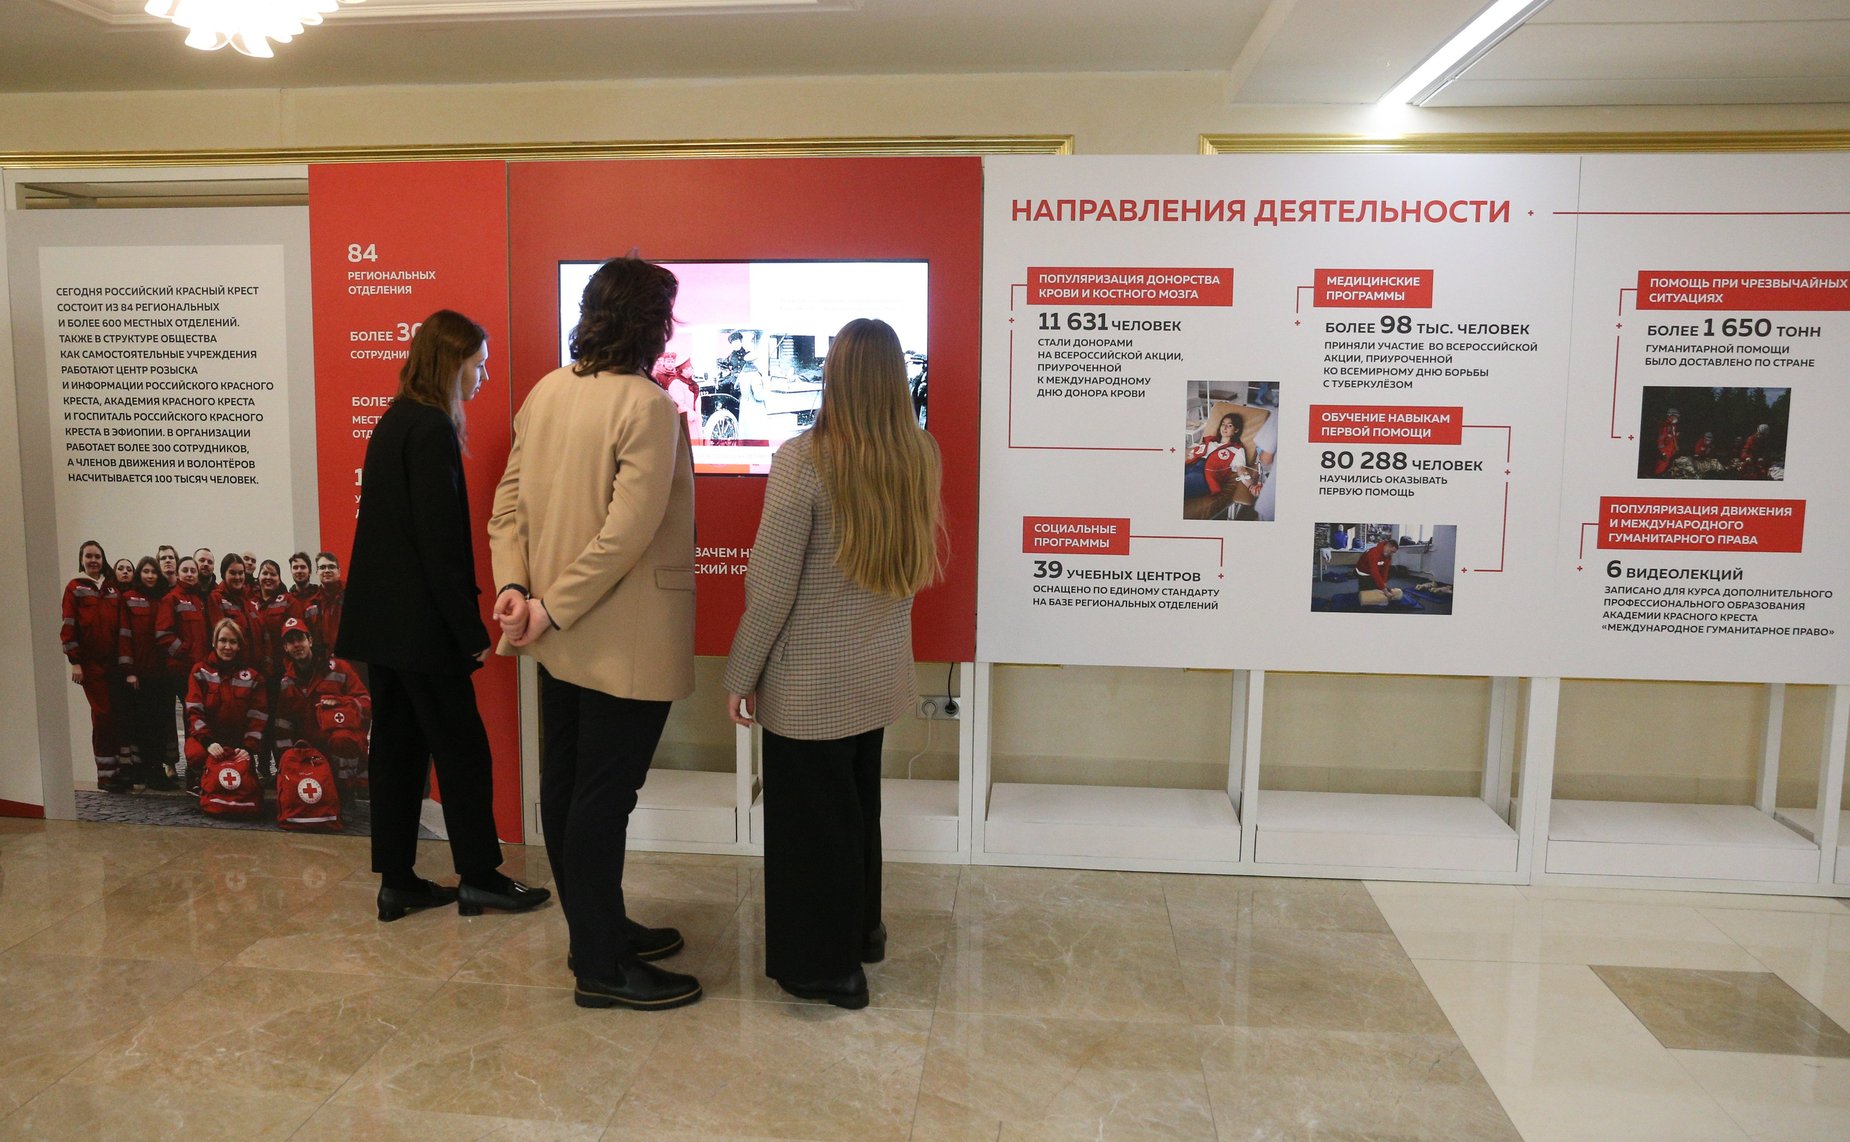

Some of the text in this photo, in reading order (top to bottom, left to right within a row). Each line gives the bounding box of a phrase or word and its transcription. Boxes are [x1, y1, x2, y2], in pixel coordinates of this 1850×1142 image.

[1011, 199, 1510, 226] НАПРАВЛЕНИЯ ДЕЯТЕЛЬНОСТИ
[347, 244, 378, 262] 84
[348, 271, 436, 280] РЕГИОНАЛЬНЫХ
[1039, 274, 1220, 286] ПОПУЛЯРИЗАЦИЯ ДОНОРСТВА
[1327, 276, 1420, 287] МЕДИЦИНСКИЕ
[1650, 277, 1848, 289] ПОМОЩЬ ПРИ ЧРЕЗВЫЧАЙНЫХ
[56, 285, 259, 297] СЕГОДНЯ РОССИЙСКИЙ КРАСНЫЙ КРЕСТ
[348, 286, 412, 295] ОТДЕЛЕНИЯ
[1039, 289, 1199, 299] КРОВИ И КОСТНОГО МОЗГА
[1326, 291, 1405, 301] ПРОГРАММЫ
[1649, 293, 1724, 304] СИТУАЦИЯХ
[57, 303, 220, 312] СОСТОИТ ИЗ 84 РЕГИОНАЛЬНЫХ
[67, 316, 240, 328] БОЛЕЕ 600 МЕСТНЫХ ОТДЕЛЕНИЙ.
[1039, 312, 1181, 331] 11 631 ЧЕЛОВЕК
[1325, 315, 1530, 335] БОЛЕЕ 98 ТЫС. ЧЕЛОВЕК
[1647, 318, 1821, 337] БОЛЕЕ 1 650 ТОНН
[59, 334, 217, 344] ТАКЖЕ СТРУКТУРЕ ОБЩЕСТВА
[350, 331, 393, 341] БОЛЕЕ
[1038, 339, 1133, 348] СТАЛИ ДОНОРАМИ
[1324, 341, 1538, 352] ПРИНЯЛИ УЧАСТИЕ ВО ВСЕРОССИЙСКОЙ
[1646, 343, 1790, 355] ГУМАНИТАРНОЙ ПОМОЩИ
[60, 350, 257, 360] КАК САМОСТОЯТЕЛЬНЫЕ УЧРЕЖДЕНИЯ
[1037, 350, 1184, 362] НА ВСЕРОССИЙСКОЙ АКЦИИ,
[1324, 353, 1453, 365] АКЦИИ, ПРИУРОЧЕННОЙ
[1037, 363, 1122, 373] ПРИУРОЧЕННОЙ
[1645, 357, 1815, 368] БЫЛО ДОСТАВЛЕНО ПО СТРАНЕ
[61, 366, 199, 376] РАБОТАЮТ ЦЕНТР РОЗЫСКА
[1323, 367, 1489, 378] КО ВСЕМИРНОМУ ДНЮ БОРЬБЫ
[71, 379, 274, 391] ИНФОРМАЦИИ РОССИЙСКОГО КРАСНОГО
[1037, 376, 1151, 387] К МЕЖДУНАРОДНОМУ
[1323, 378, 1413, 389] С ТУБЕРКУЛЁЗОМ
[1037, 389, 1146, 398] ДНЮ ДОНОРА КРОВИ
[63, 397, 255, 407] КРЕСТА, АКАДЕМИЯ КРАСНОГО КРЕСТА
[73, 411, 264, 422] ГОСПИТАЛЬ РОССИЙСКОГО КРАСНОГО
[1321, 412, 1450, 423] ОБУЧЕНИЕ НАВЫКАМ
[65, 428, 251, 439] КРЕСТА ЭФИОПИИ. ОРГАНИЗАЦИИ
[1321, 426, 1432, 439] ПЕРВОЙ ПОМОЩИ
[66, 443, 249, 455] РАБОТАЕТ БОЛЕЕ 300 СОТРУДНИКОВ,
[76, 457, 256, 469] ЧЛЕНОВ ДВИЖЕНИЯ ВОЛОНТЁРОВ
[1320, 451, 1483, 472] 80 288 ЧЕЛОВЕК
[68, 473, 259, 485] НАСЧИТЫВАЕТСЯ 100 ТЫСЯЧ ЧЕЛОВЕК.
[1319, 474, 1448, 485] НАУЧИЛИСЬ ОКАЗЫВАТЬ
[1319, 487, 1415, 498] ПЕРВУЮ ПОМОЩЬ
[1610, 504, 1793, 518] ПОПУЛЯРИЗАЦИЯ ДВИЖЕНИЯ
[1034, 523, 1117, 535] СОЦИАЛЬНЫЕ
[1609, 519, 1744, 531] И МЕЖДУНАРОДНОГО
[1034, 538, 1110, 548] ПРОГРАММЫ
[1608, 533, 1758, 545] ГУМАНИТАРНОГО ПРАВА
[1033, 560, 1201, 583] 39 УЧЕБНЫХ ЦЕНТРОВ
[1606, 559, 1743, 581] 6 ВИДЕОЛЕКЦИЙ
[1033, 585, 1220, 597] ОСНАЩЕНО ПО ЕДИНОМУ СТАНДАРТУ
[1604, 586, 1833, 599] ЗАПИСАНО ДЛЯ КУРСА ДОПОЛНИТЕЛЬНОГО
[1032, 598, 1219, 610] НА БАЗЕ РЕГИОНАЛЬНЫХ ОТДЕЛЕНИЙ
[1603, 598, 1805, 611] ПРОФЕССИОНАЛЬНОГО ОБРАЗОВАНИЯ
[1602, 611, 1758, 622] АКАДЕМИИ КРАСНОГО КРЕСТА
[1601, 623, 1835, 637] «МЕЖДУНАРОДНОЕ ГУМАНИТАРНОЕ ПРАВО»
